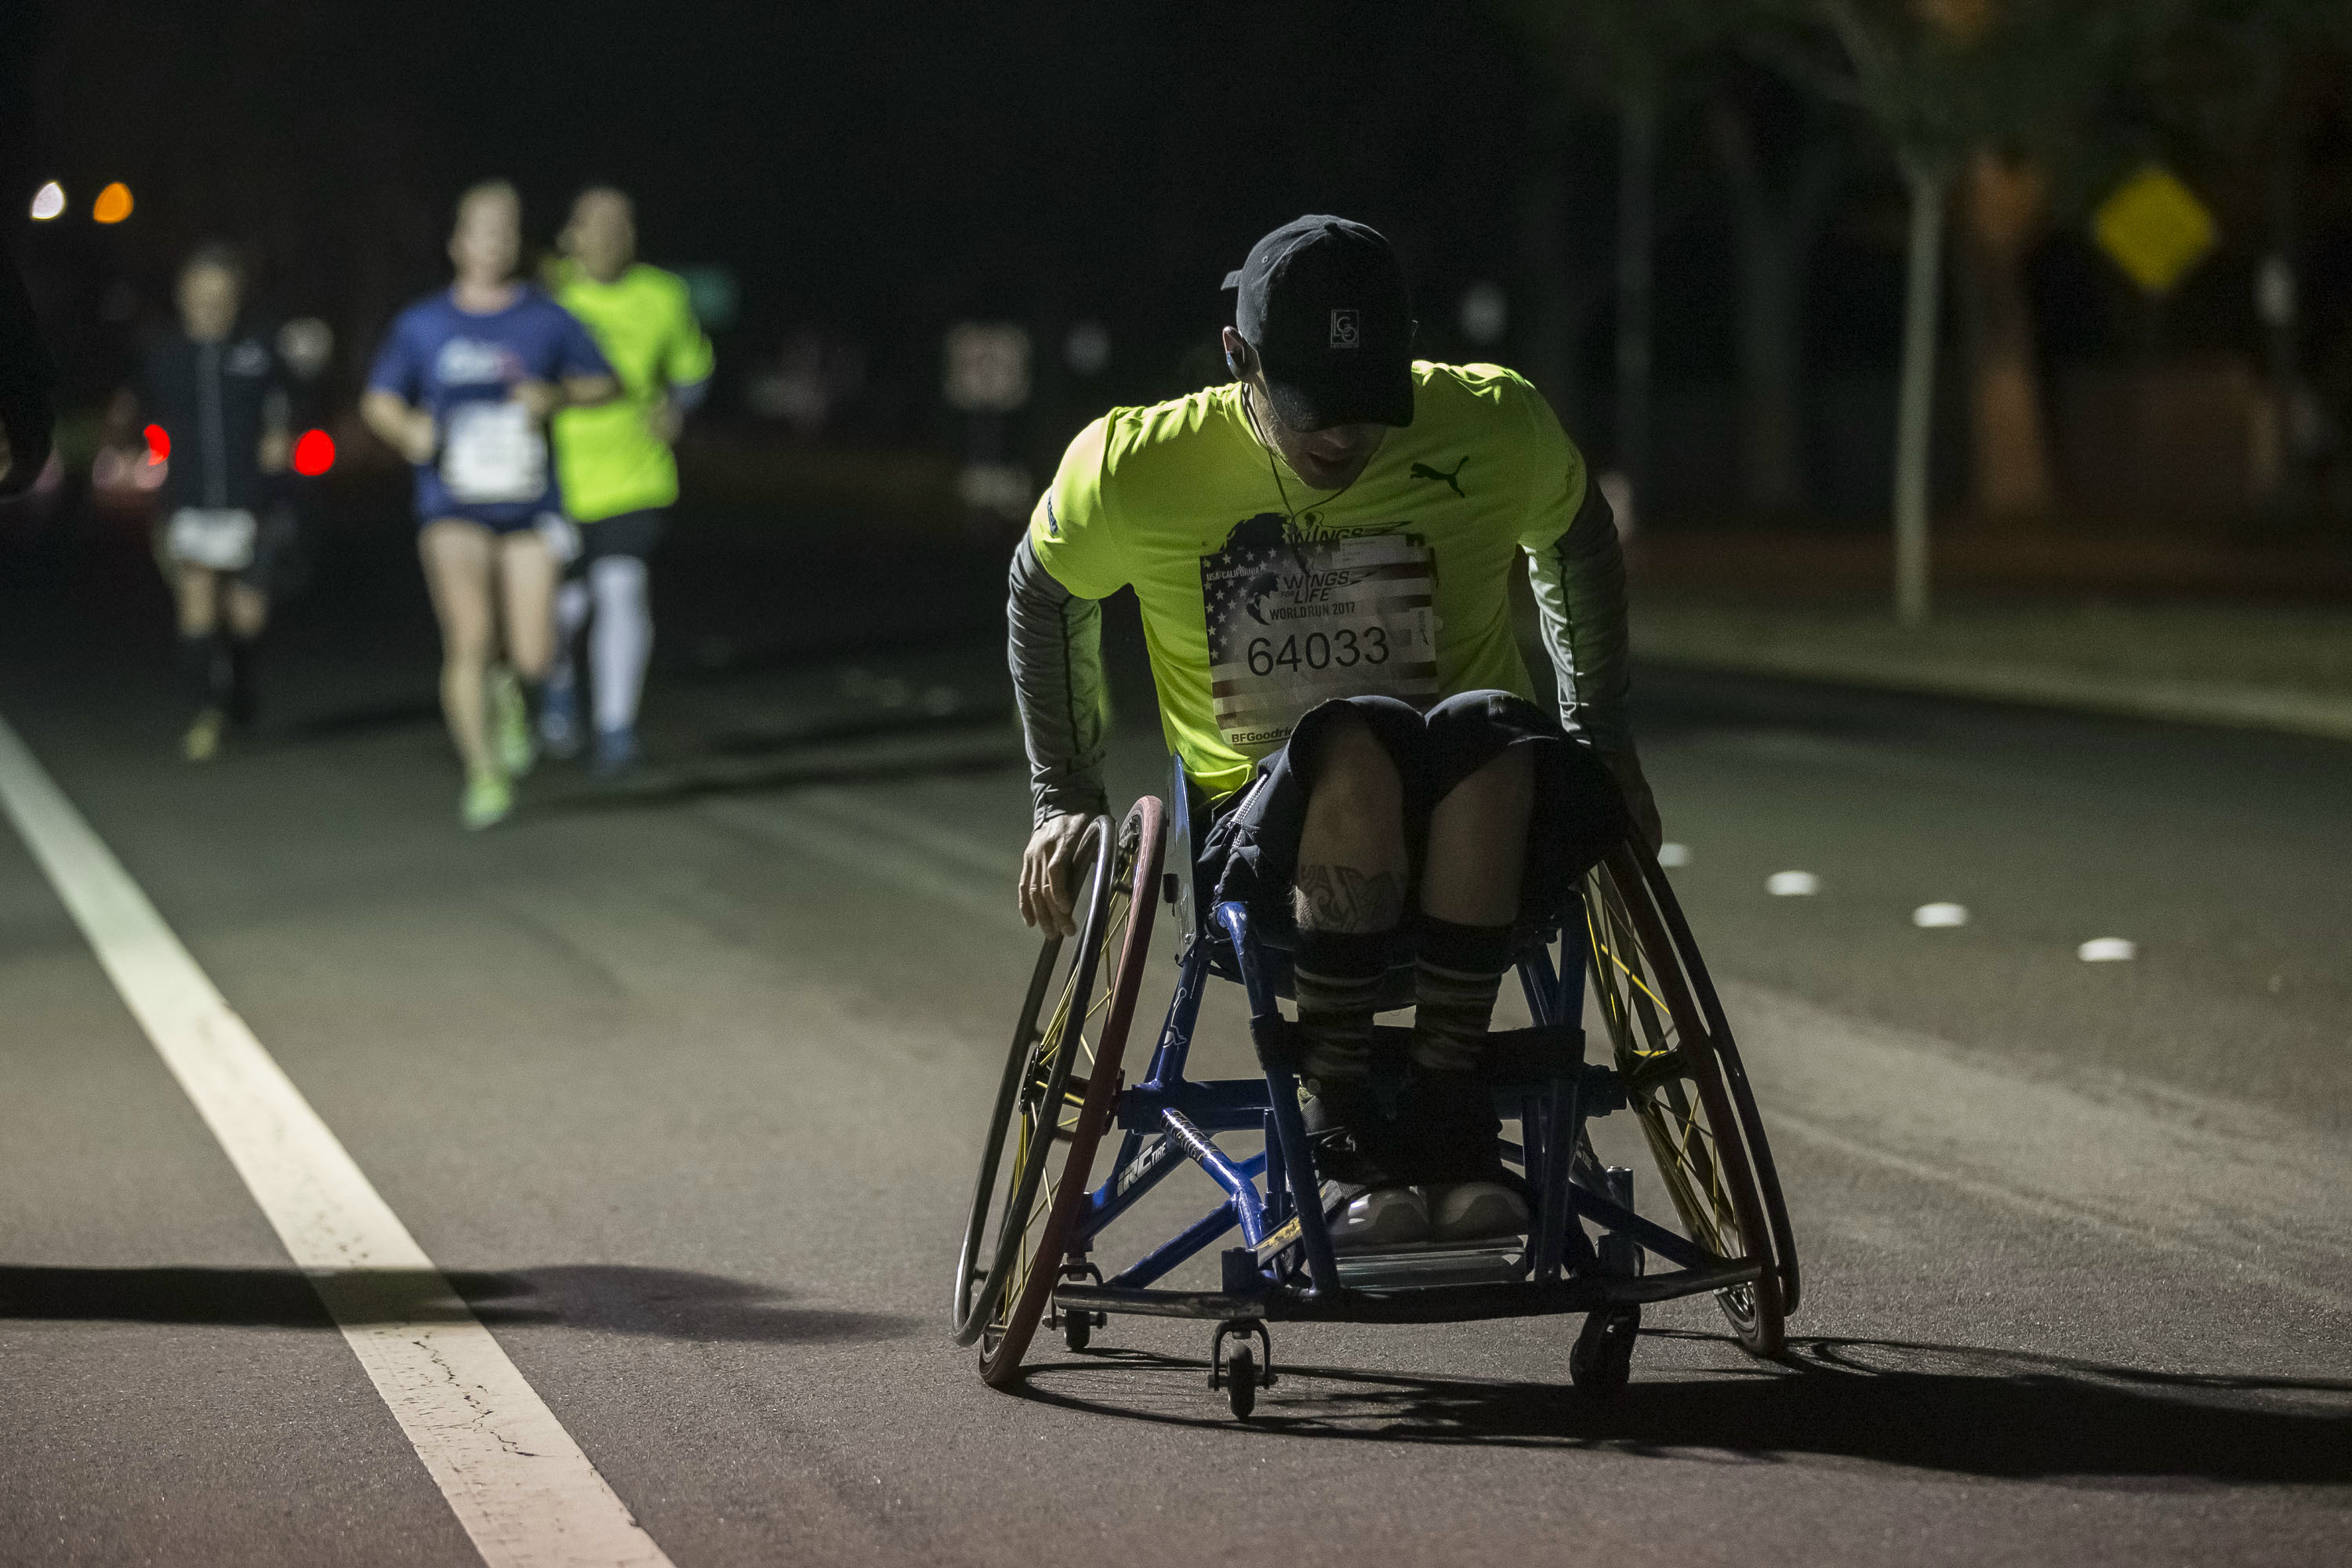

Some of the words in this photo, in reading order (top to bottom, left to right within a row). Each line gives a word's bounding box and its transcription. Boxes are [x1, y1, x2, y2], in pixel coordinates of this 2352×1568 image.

[1283, 571, 1350, 590] WINGS
[1294, 587, 1332, 604] LIFE
[1332, 601, 1356, 615] 2017
[1247, 626, 1390, 677] 64033
[1152, 1142, 1167, 1166] TIRE
